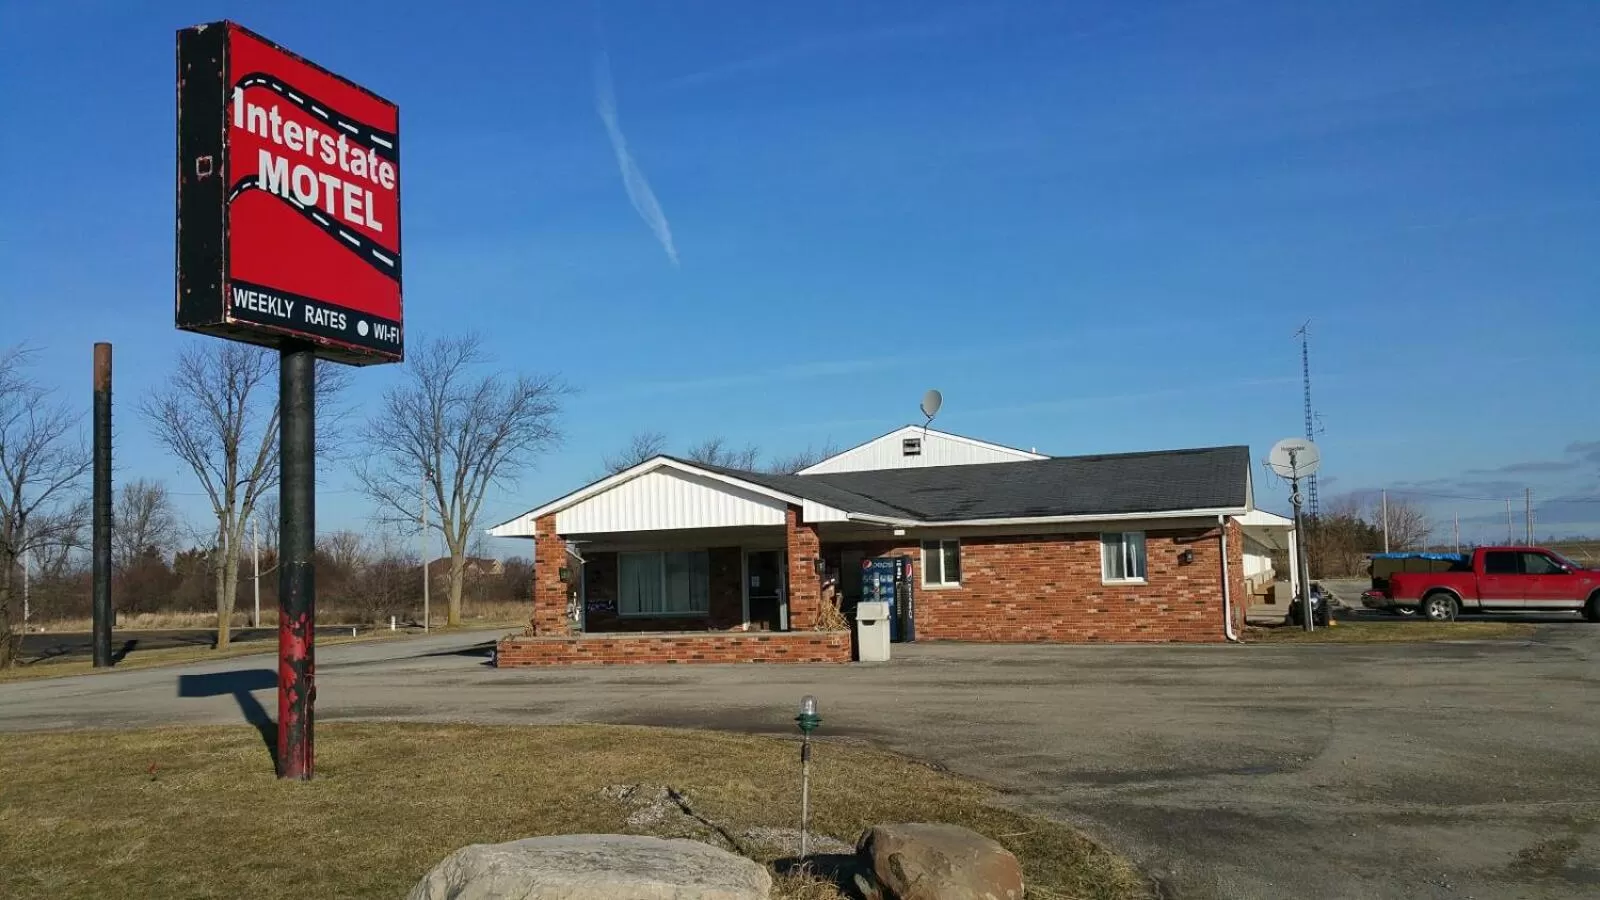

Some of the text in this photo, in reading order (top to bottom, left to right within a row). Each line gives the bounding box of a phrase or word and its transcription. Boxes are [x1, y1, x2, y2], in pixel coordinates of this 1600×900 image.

[232, 86, 395, 190] Interstate
[258, 148, 383, 232] MOTEL
[233, 287, 400, 345] WEEKLY RATES WI-FI
